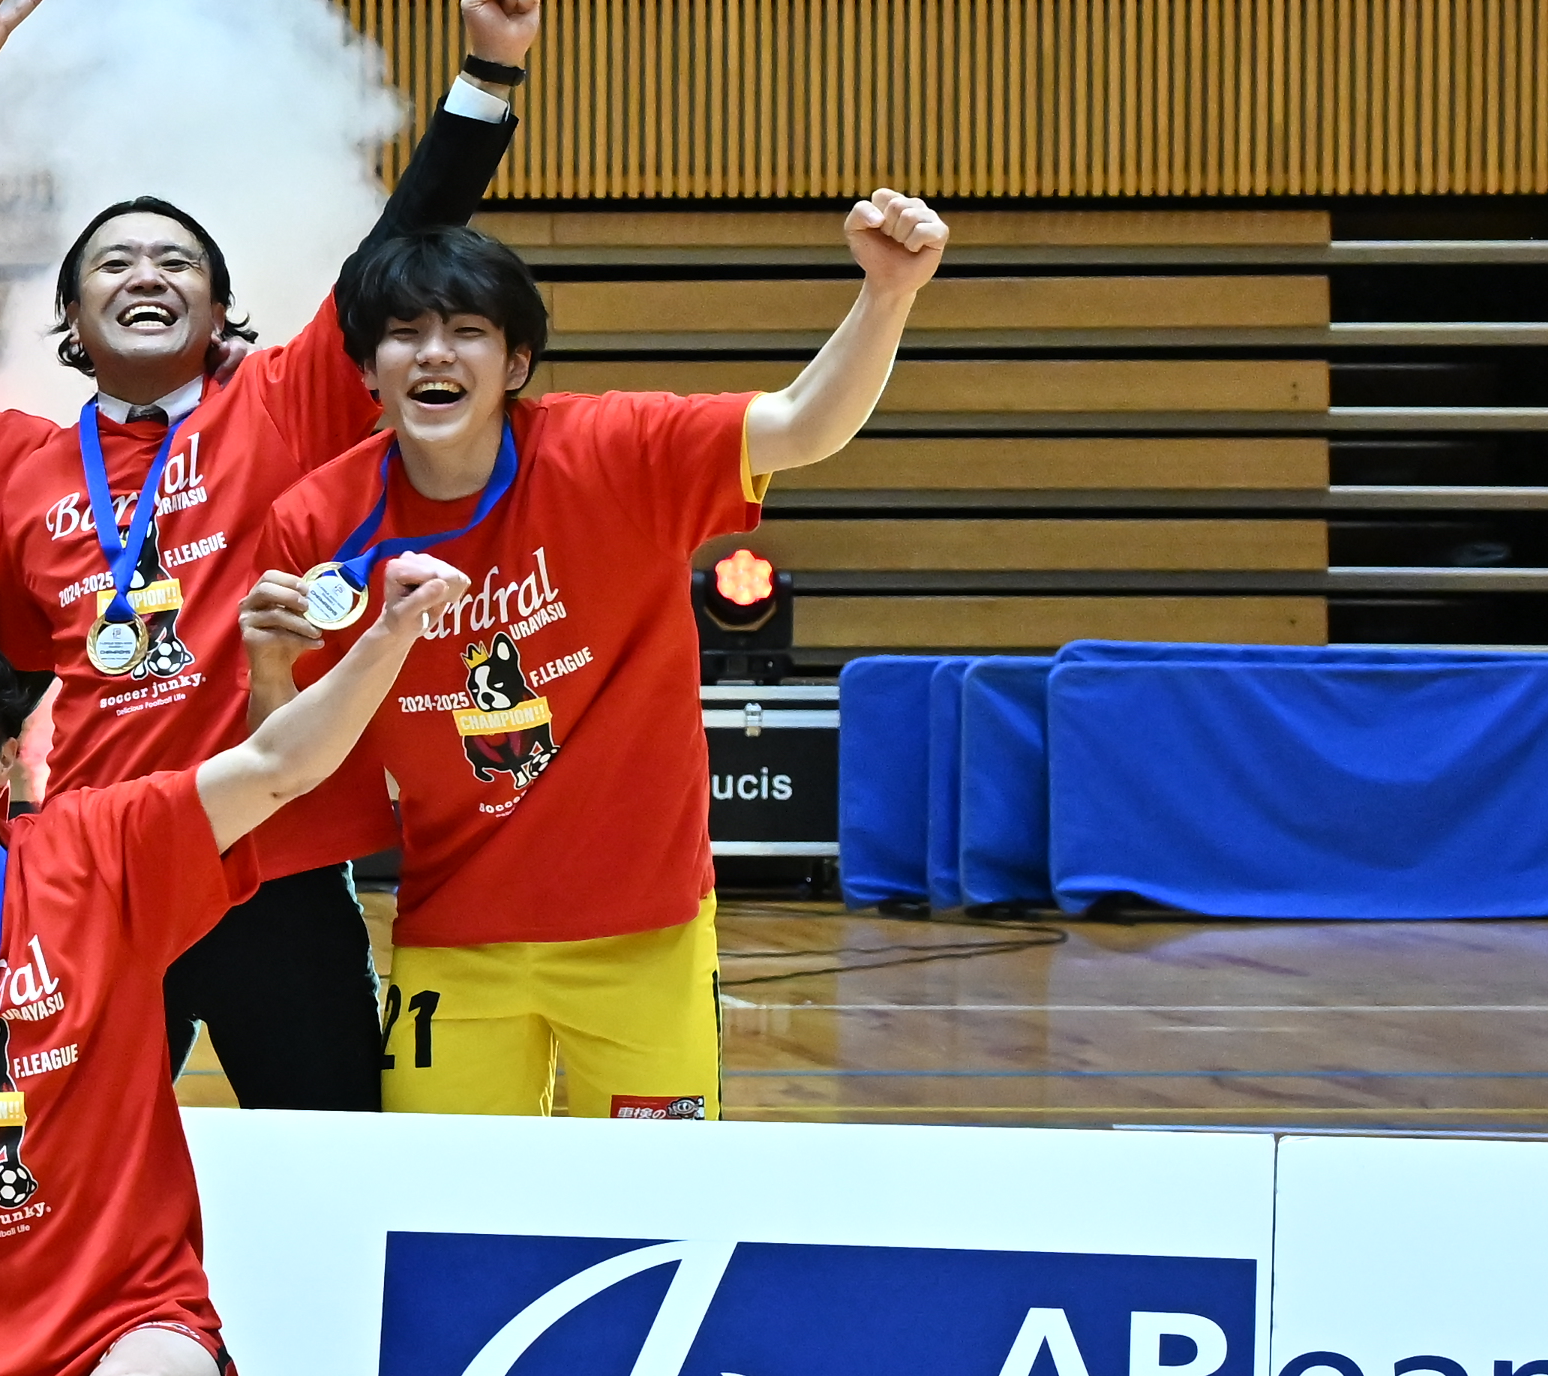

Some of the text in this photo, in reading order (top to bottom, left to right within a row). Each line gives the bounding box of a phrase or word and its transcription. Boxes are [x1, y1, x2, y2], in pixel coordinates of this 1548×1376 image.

[164, 531, 228, 568] F.LEAGUE
[58, 571, 114, 608] 2024-2025
[423, 546, 560, 642] ardral
[508, 601, 567, 642] URAYASU
[529, 646, 595, 688] F.LEAGUE
[99, 672, 207, 709] soccer junky.
[398, 691, 470, 713] 2024-2025
[116, 704, 144, 716] Delicious
[458, 702, 548, 731] CHAMPION!!
[380, 984, 441, 1070] 21
[13, 1043, 79, 1079] F.LEAGUE
